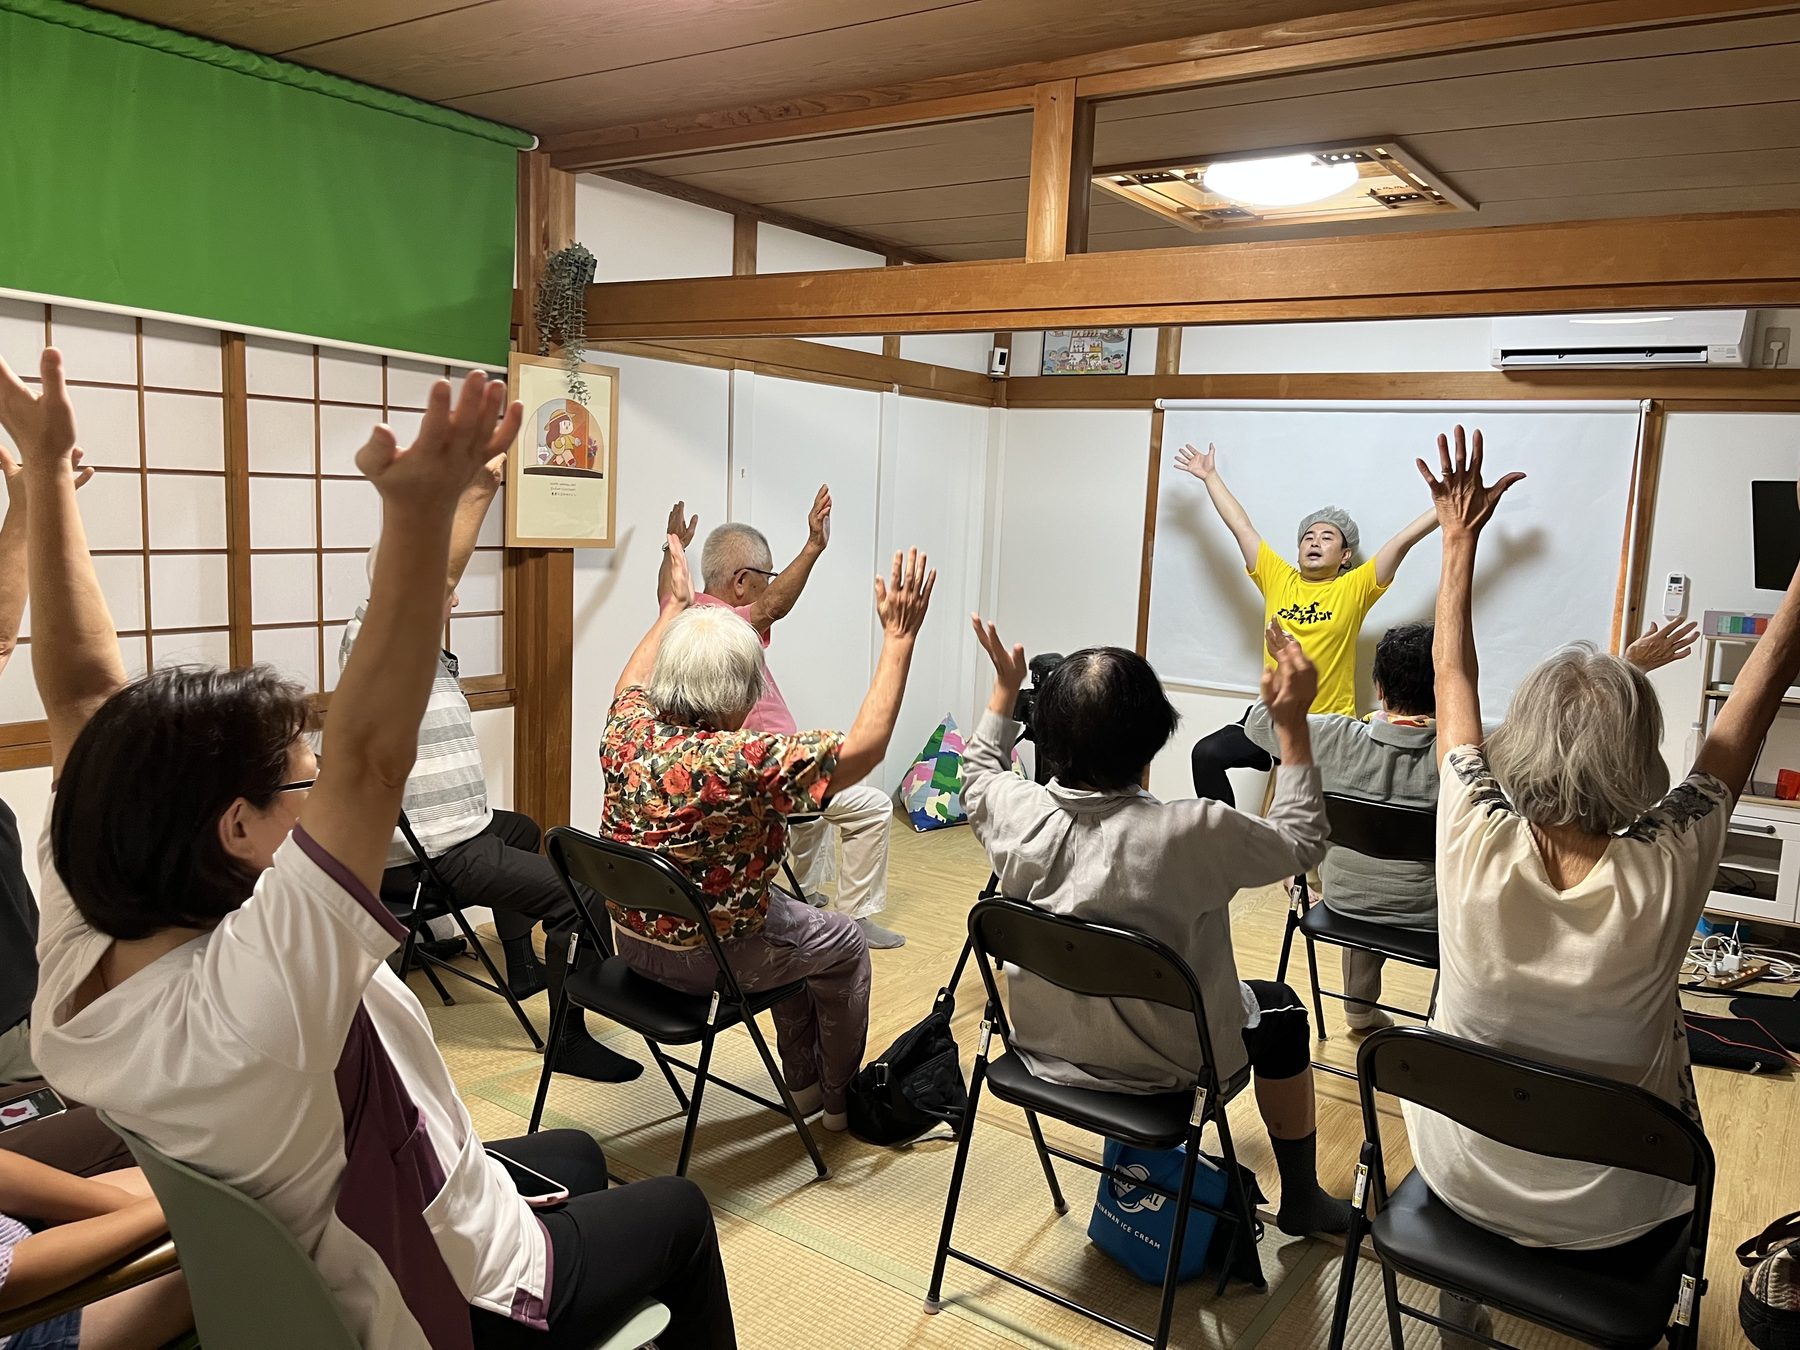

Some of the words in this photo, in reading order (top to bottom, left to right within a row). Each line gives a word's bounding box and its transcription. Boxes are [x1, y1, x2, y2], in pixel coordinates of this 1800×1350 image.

[1096, 1201, 1120, 1225] KINAWAN
[1120, 1222, 1133, 1234] ICE
[1134, 1230, 1161, 1250] CREAM
